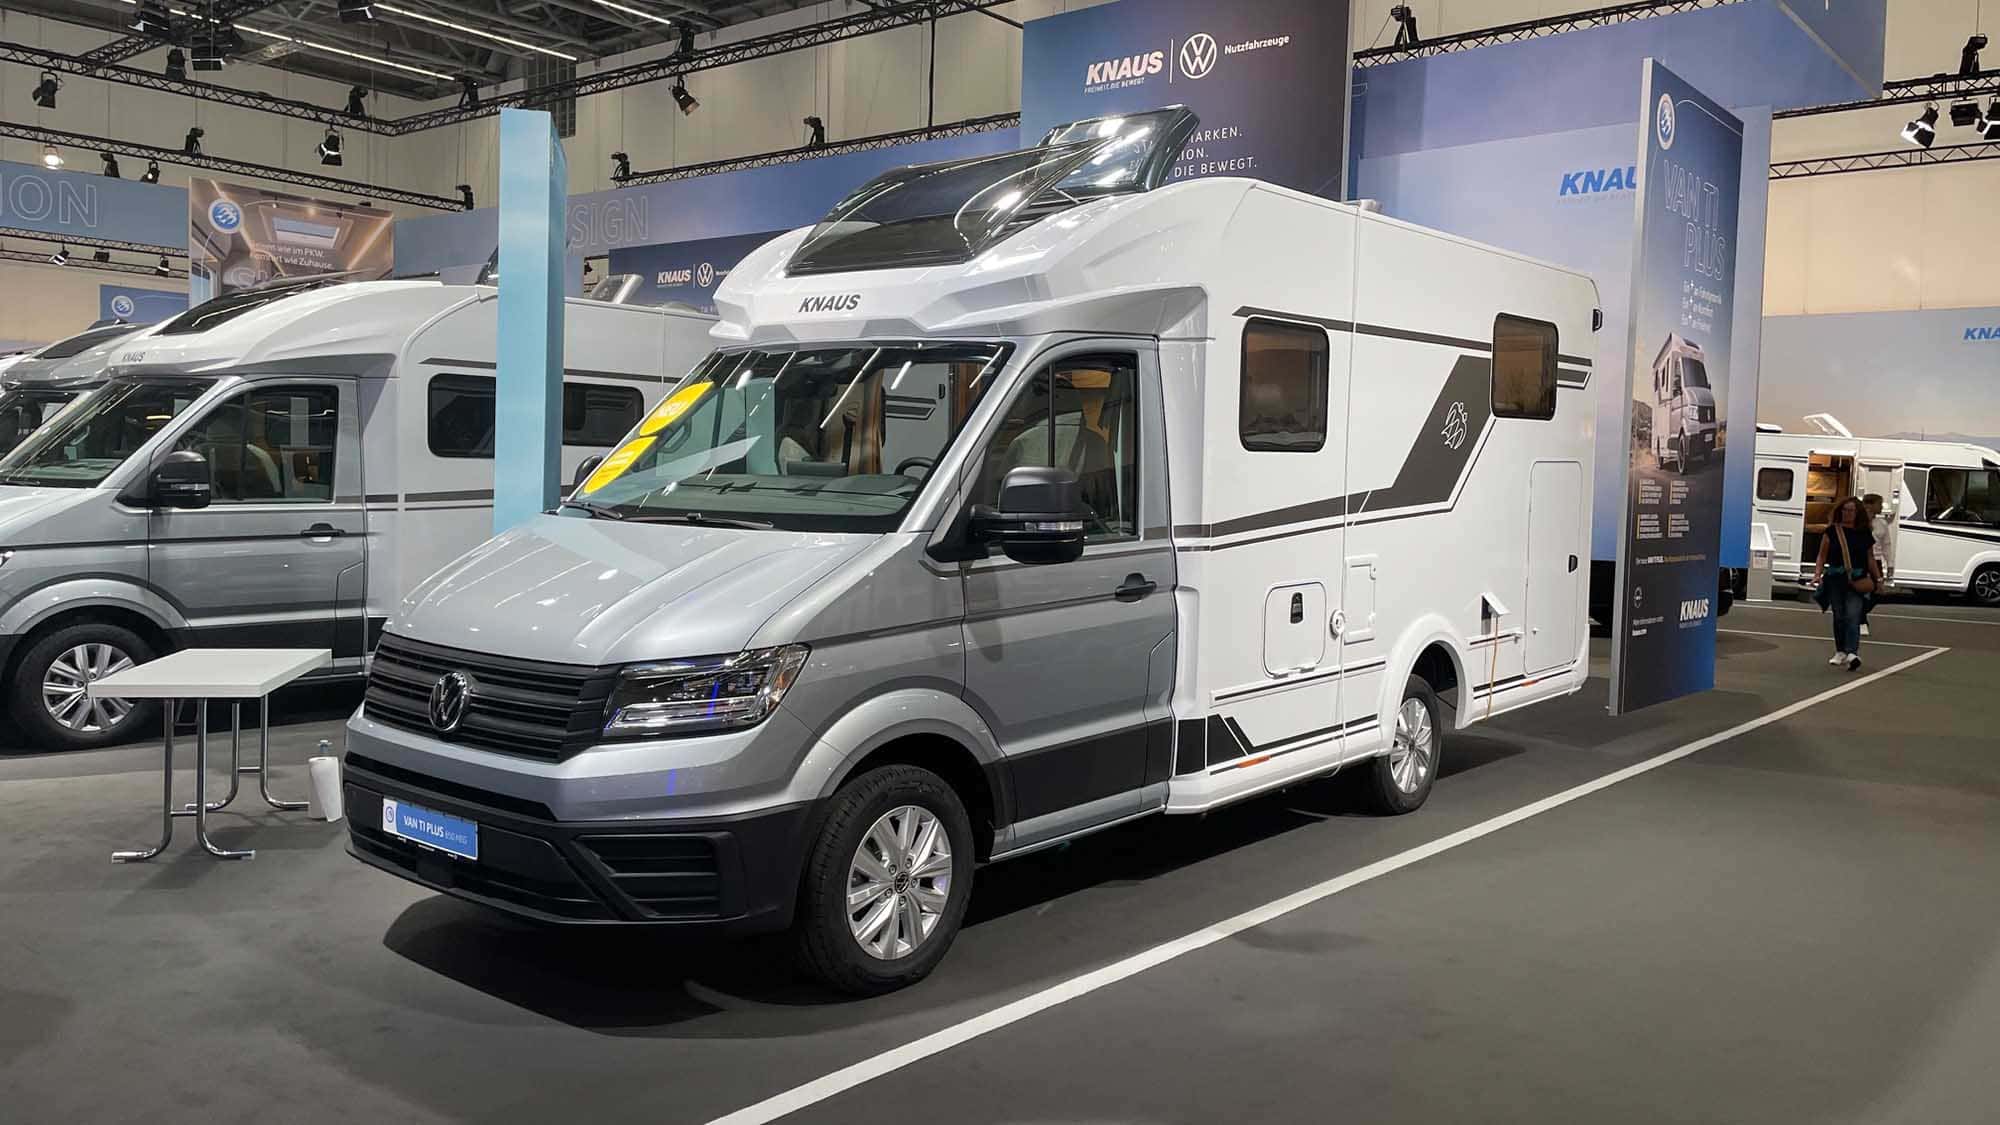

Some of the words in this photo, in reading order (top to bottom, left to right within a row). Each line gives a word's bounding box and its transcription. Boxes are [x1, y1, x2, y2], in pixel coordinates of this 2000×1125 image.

[1224, 35, 1290, 55] Nutzfahrzeuge
[1086, 51, 1164, 85] KNAUS
[1176, 148, 1209, 162] ION.
[1174, 164, 1195, 178] DIE
[1200, 157, 1258, 175] BEWEGT.
[1663, 159, 1701, 223] VAN
[567, 195, 650, 250] SIGN
[1683, 222, 1726, 281] PLUS
[657, 269, 691, 285] KNAUS
[799, 293, 861, 313] KNAUS
[1680, 598, 1709, 621] KNAUS
[403, 815, 418, 830] VAN
[419, 819, 426, 833] TI
[426, 822, 444, 838] PLUS
